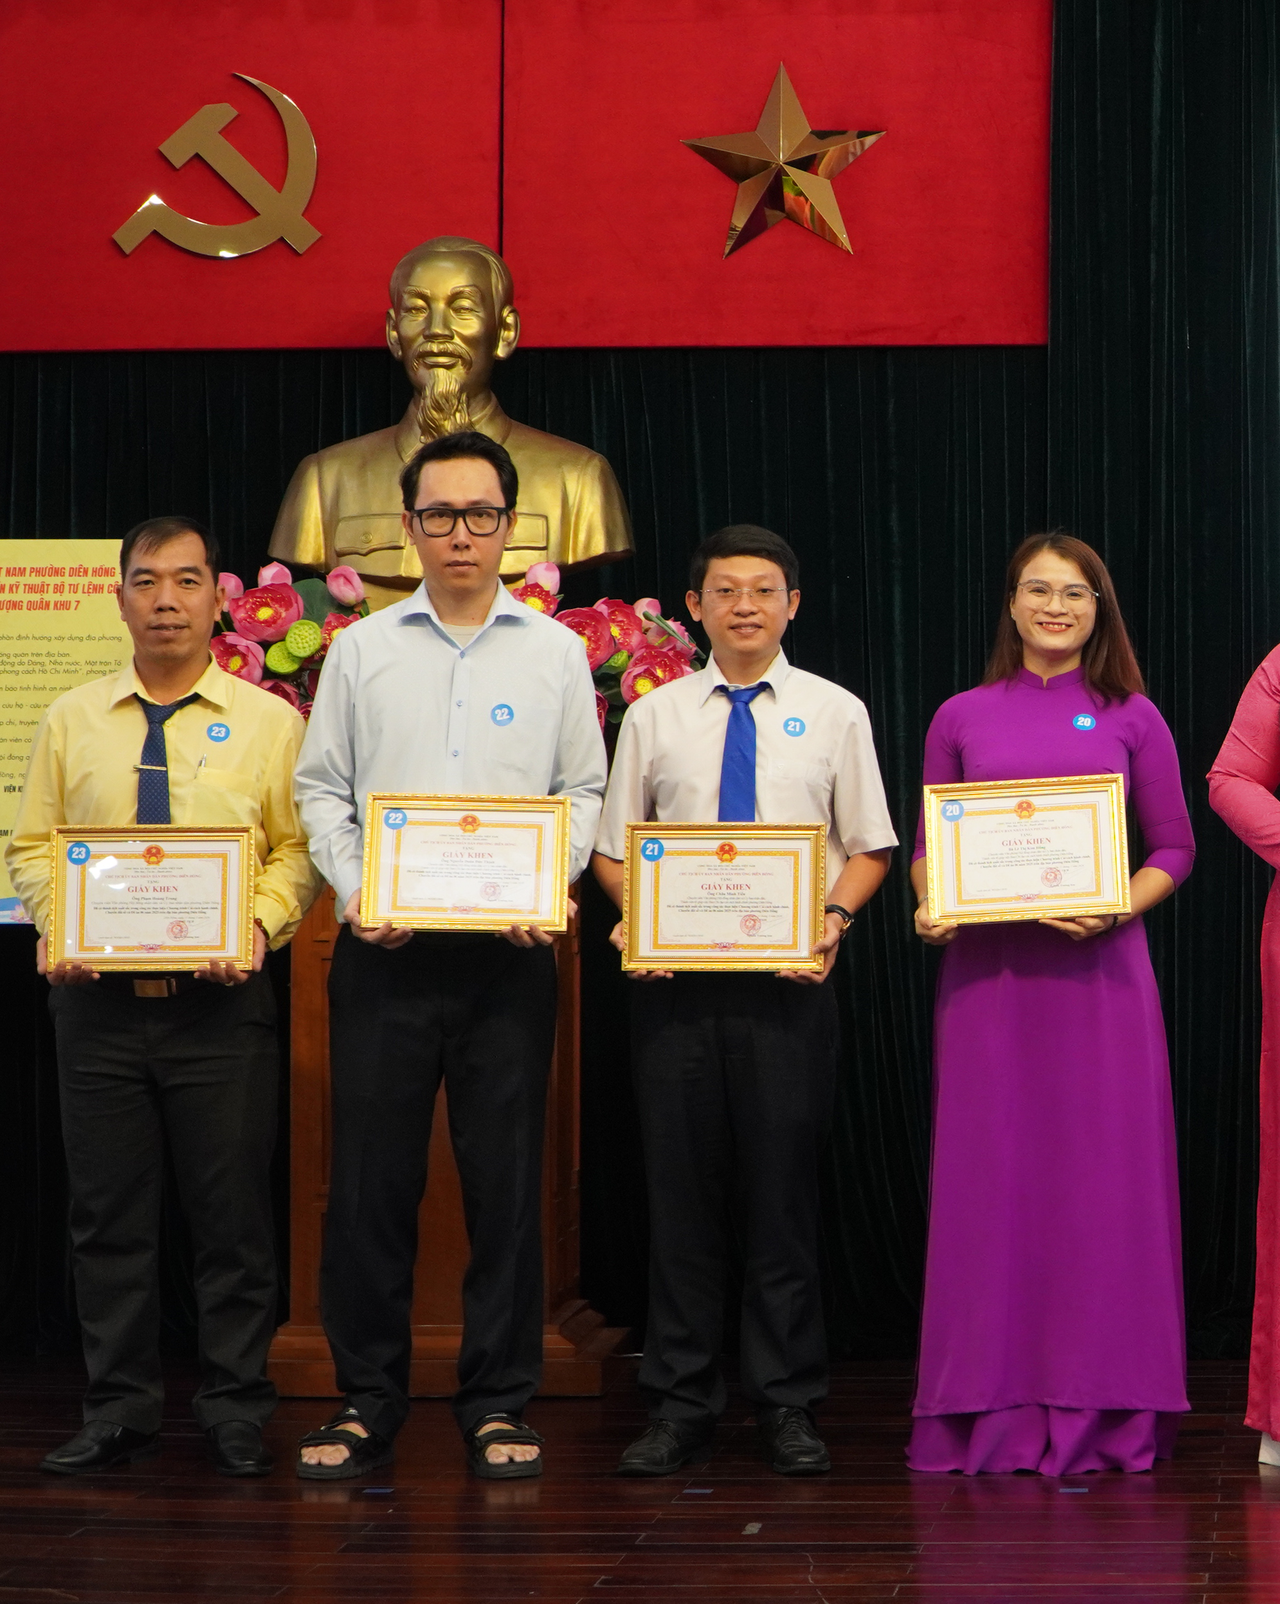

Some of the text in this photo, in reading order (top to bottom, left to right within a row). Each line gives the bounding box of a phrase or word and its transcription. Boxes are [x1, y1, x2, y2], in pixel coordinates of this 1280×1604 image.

[5, 566, 26, 578] NAM
[29, 564, 66, 578] PHƯỜNG
[68, 564, 88, 578] DIÊN
[91, 564, 116, 578] HỒNG
[9, 581, 21, 595] KỸ
[23, 581, 51, 596] THUẬT
[53, 581, 65, 597] BỘ
[68, 583, 80, 595] TƯ
[82, 581, 104, 597] LỆNH
[0, 598, 81, 613] ƯỢNG QUÂN KHU 7
[494, 707, 510, 721] 22
[787, 720, 800, 732] 21
[1076, 716, 1092, 727] 20
[210, 726, 226, 738] 23
[945, 804, 959, 816] 20
[388, 812, 403, 824] 22
[71, 847, 86, 859] 23
[645, 843, 659, 856] 21
[127, 884, 149, 893] GIẤY
[701, 882, 723, 890] GIẤY
